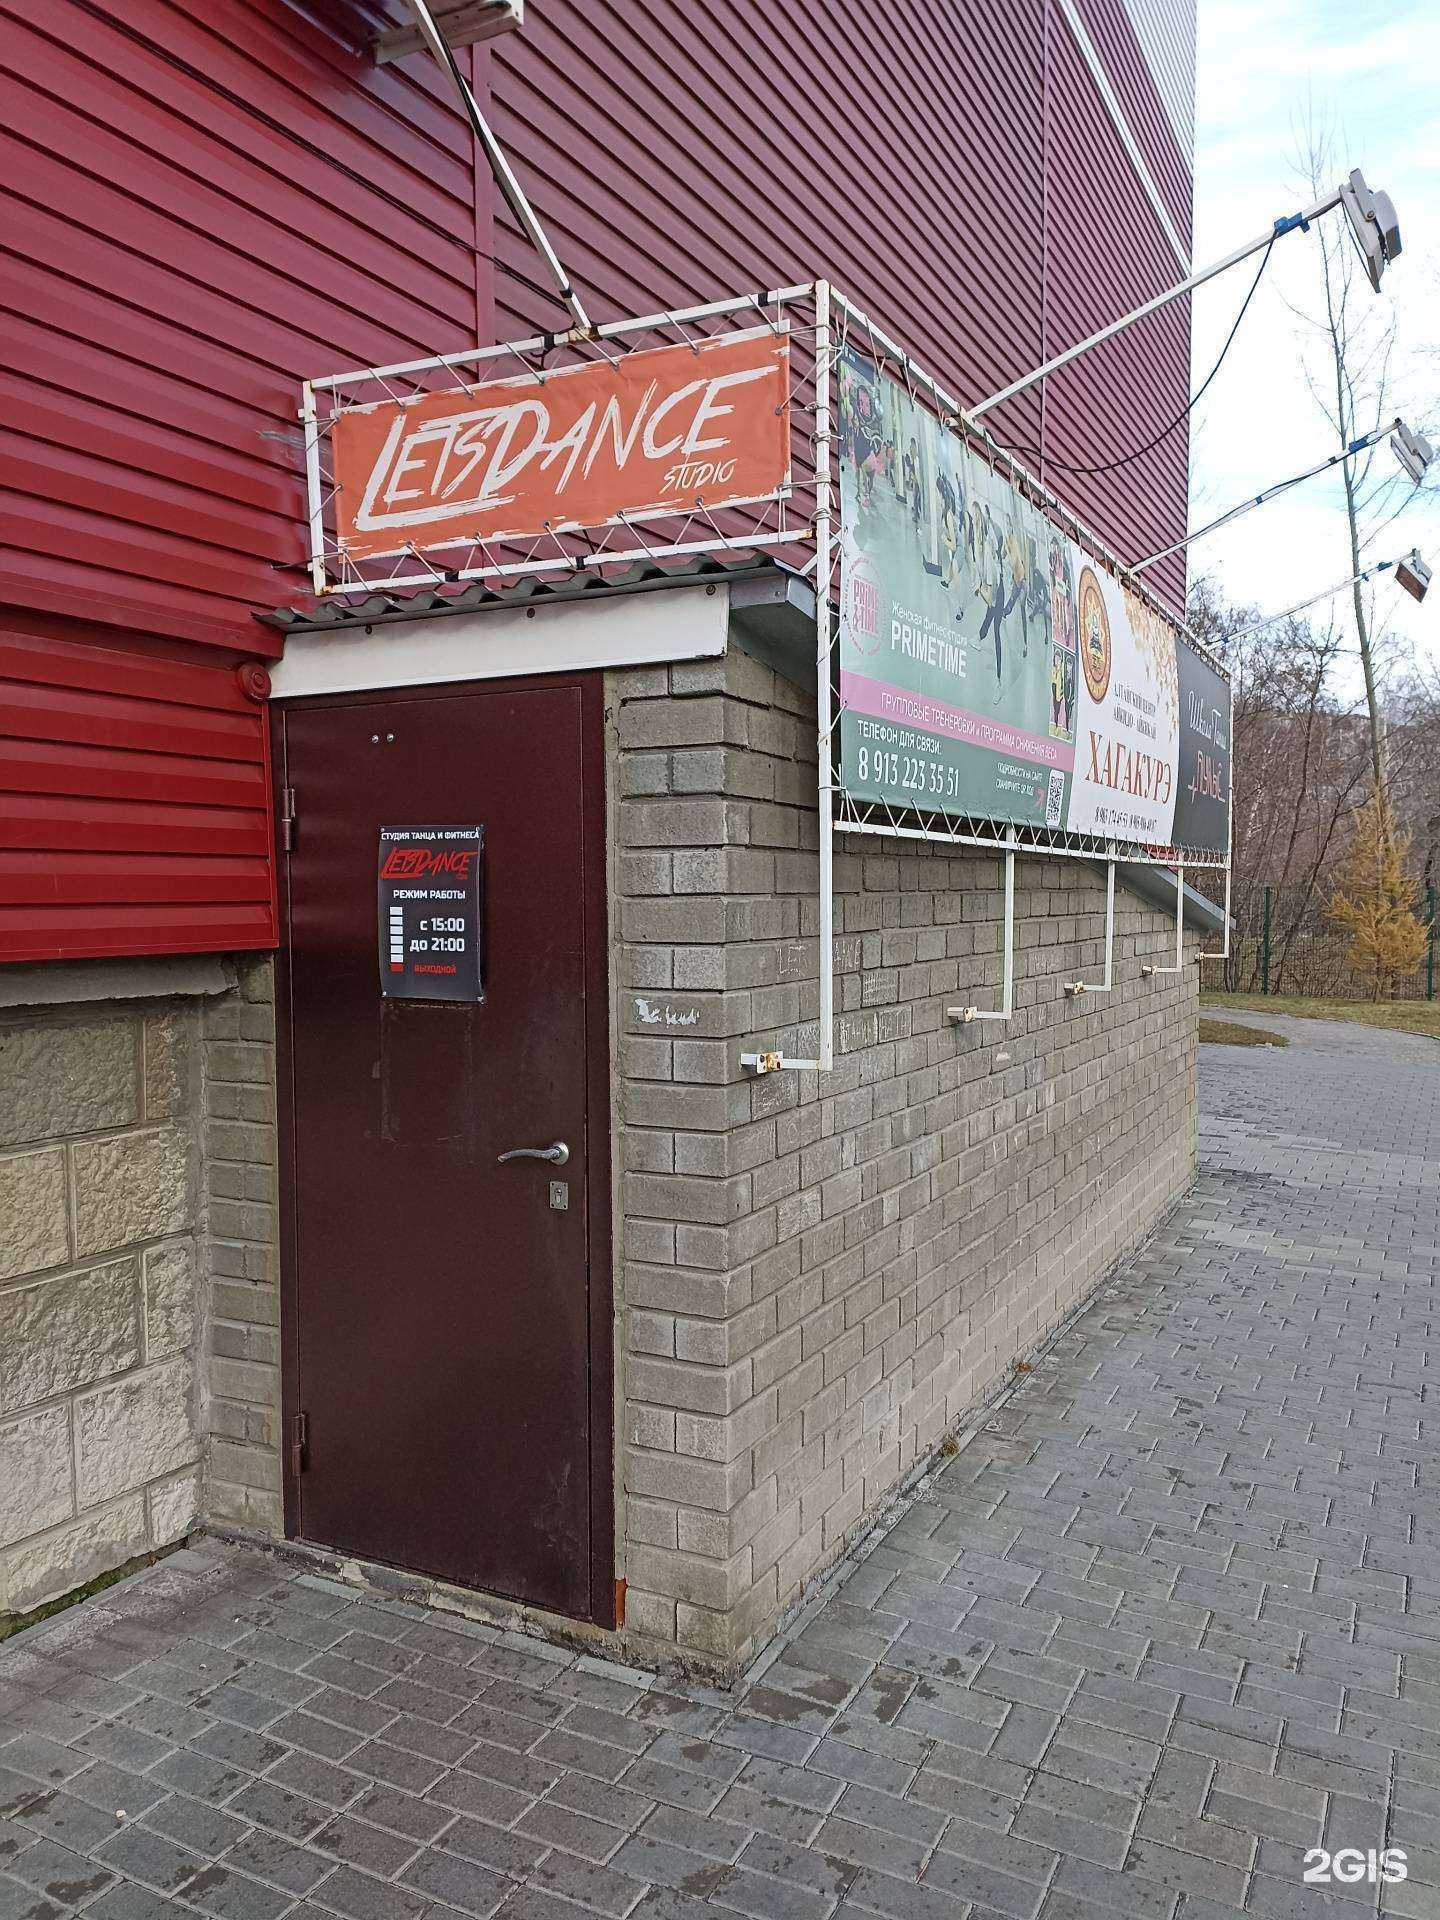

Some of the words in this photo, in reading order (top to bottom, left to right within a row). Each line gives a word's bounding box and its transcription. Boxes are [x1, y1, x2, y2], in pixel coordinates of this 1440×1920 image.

[659, 455, 739, 495] STUDIO
[891, 620, 967, 678] PRIMETIME
[881, 692, 930, 722] ГРУППОВЫЕ
[857, 719, 898, 743] ТЕЛЕФОН
[899, 731, 915, 748] ДЛЯ
[916, 735, 942, 756] СВЯЗИ:
[858, 746, 869, 781] 8
[873, 750, 899, 786] 913
[901, 756, 926, 790] 223
[928, 762, 944, 794] 35
[946, 766, 959, 797] 51
[1085, 730, 1172, 805] ХАГАКУРЭ
[381, 832, 410, 841] СТУДИЯ
[411, 832, 436, 841] ТАНЦА
[437, 832, 444, 840] И
[444, 831, 480, 840] ФИТНЕСА
[393, 889, 428, 899] РЕЖИМ
[429, 890, 466, 899] РАБОТЫ
[430, 917, 465, 932] 15:00
[409, 939, 428, 952] до
[431, 937, 465, 952] 21:00
[414, 963, 457, 974] ВЫХОДНОЙ
